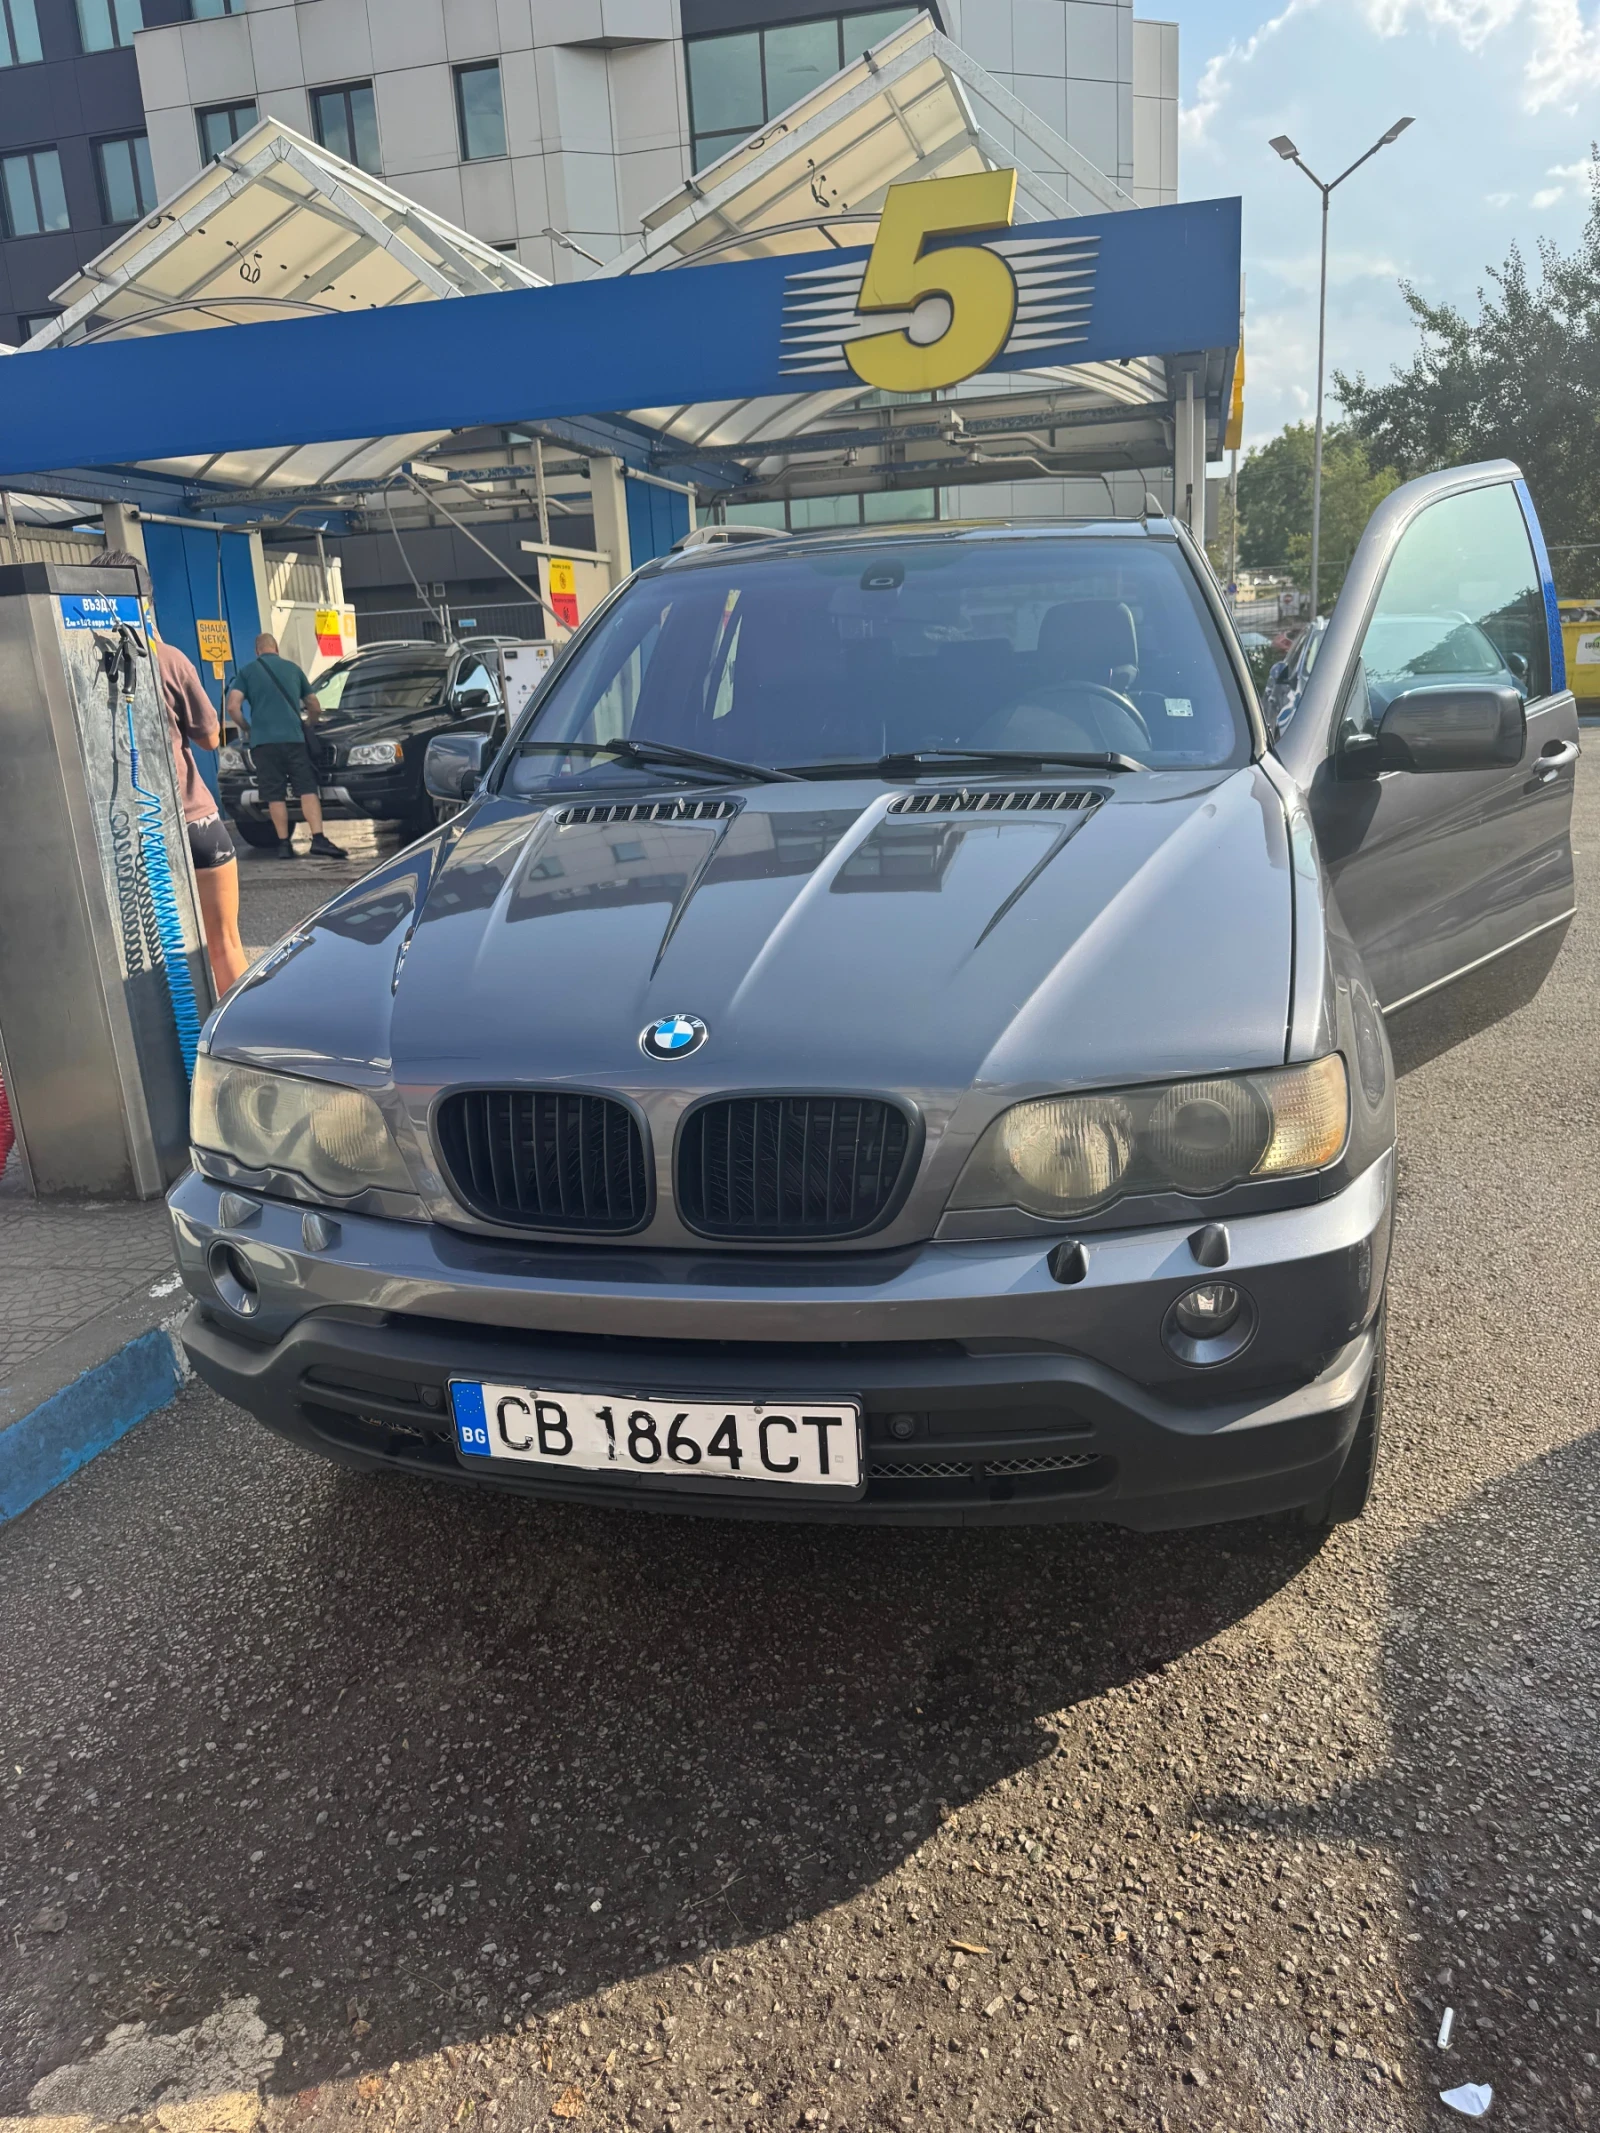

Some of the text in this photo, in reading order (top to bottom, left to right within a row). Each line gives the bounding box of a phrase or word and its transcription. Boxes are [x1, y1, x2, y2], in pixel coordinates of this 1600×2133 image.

[843, 168, 1017, 393] 5
[201, 634, 228, 644] ЧЕТКА
[653, 1015, 704, 1028] BMW
[496, 1396, 573, 1456] CB
[462, 1427, 486, 1444] BG
